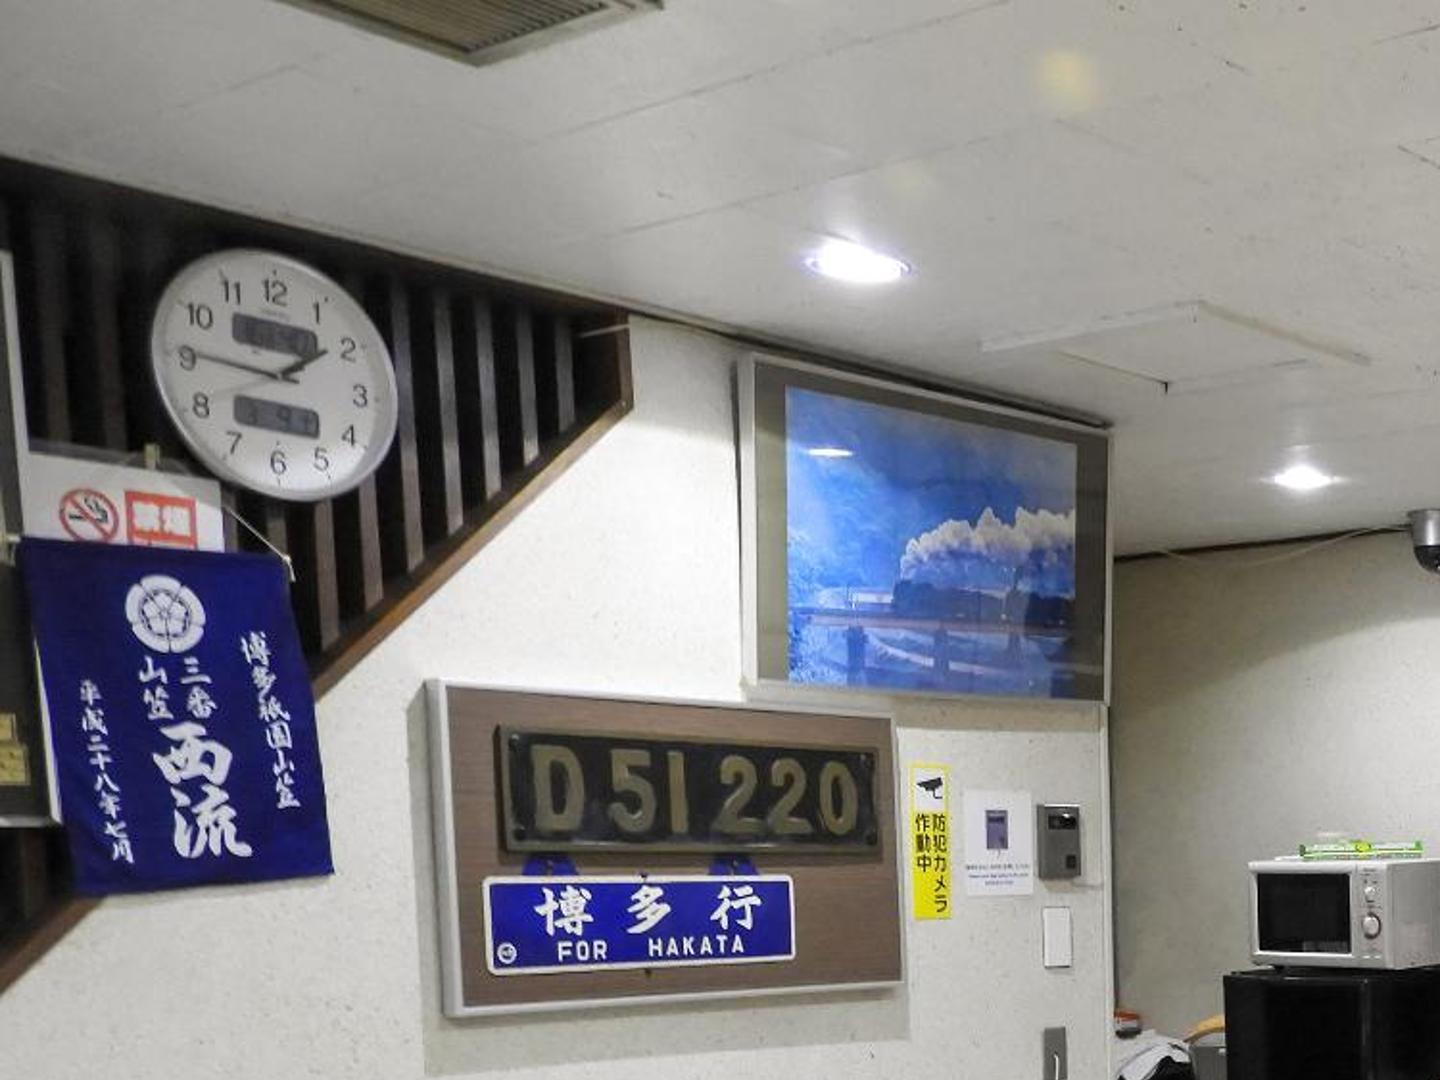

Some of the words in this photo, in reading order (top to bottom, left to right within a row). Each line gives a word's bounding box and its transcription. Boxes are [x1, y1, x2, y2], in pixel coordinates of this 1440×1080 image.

[221, 279, 241, 305] 11
[262, 279, 289, 305] 12
[186, 302, 214, 329] 10
[312, 303, 323, 324] 1
[179, 346, 197, 369] 9
[339, 337, 357, 362] 2
[192, 393, 210, 419] 8
[352, 384, 369, 408] 3
[226, 431, 243, 453] 7
[341, 423, 356, 447] 4
[270, 451, 287, 475] 6
[313, 447, 330, 472] 5
[138, 655, 174, 721] 山笠
[179, 656, 219, 720] 三番
[152, 720, 253, 859] 西流
[714, 754, 860, 837] 220
[915, 813, 932, 873] 作動中
[932, 813, 948, 913] 防犯カメラ
[532, 884, 764, 938] 博多行
[556, 938, 608, 962] FOR
[647, 933, 746, 959] HAKATA
